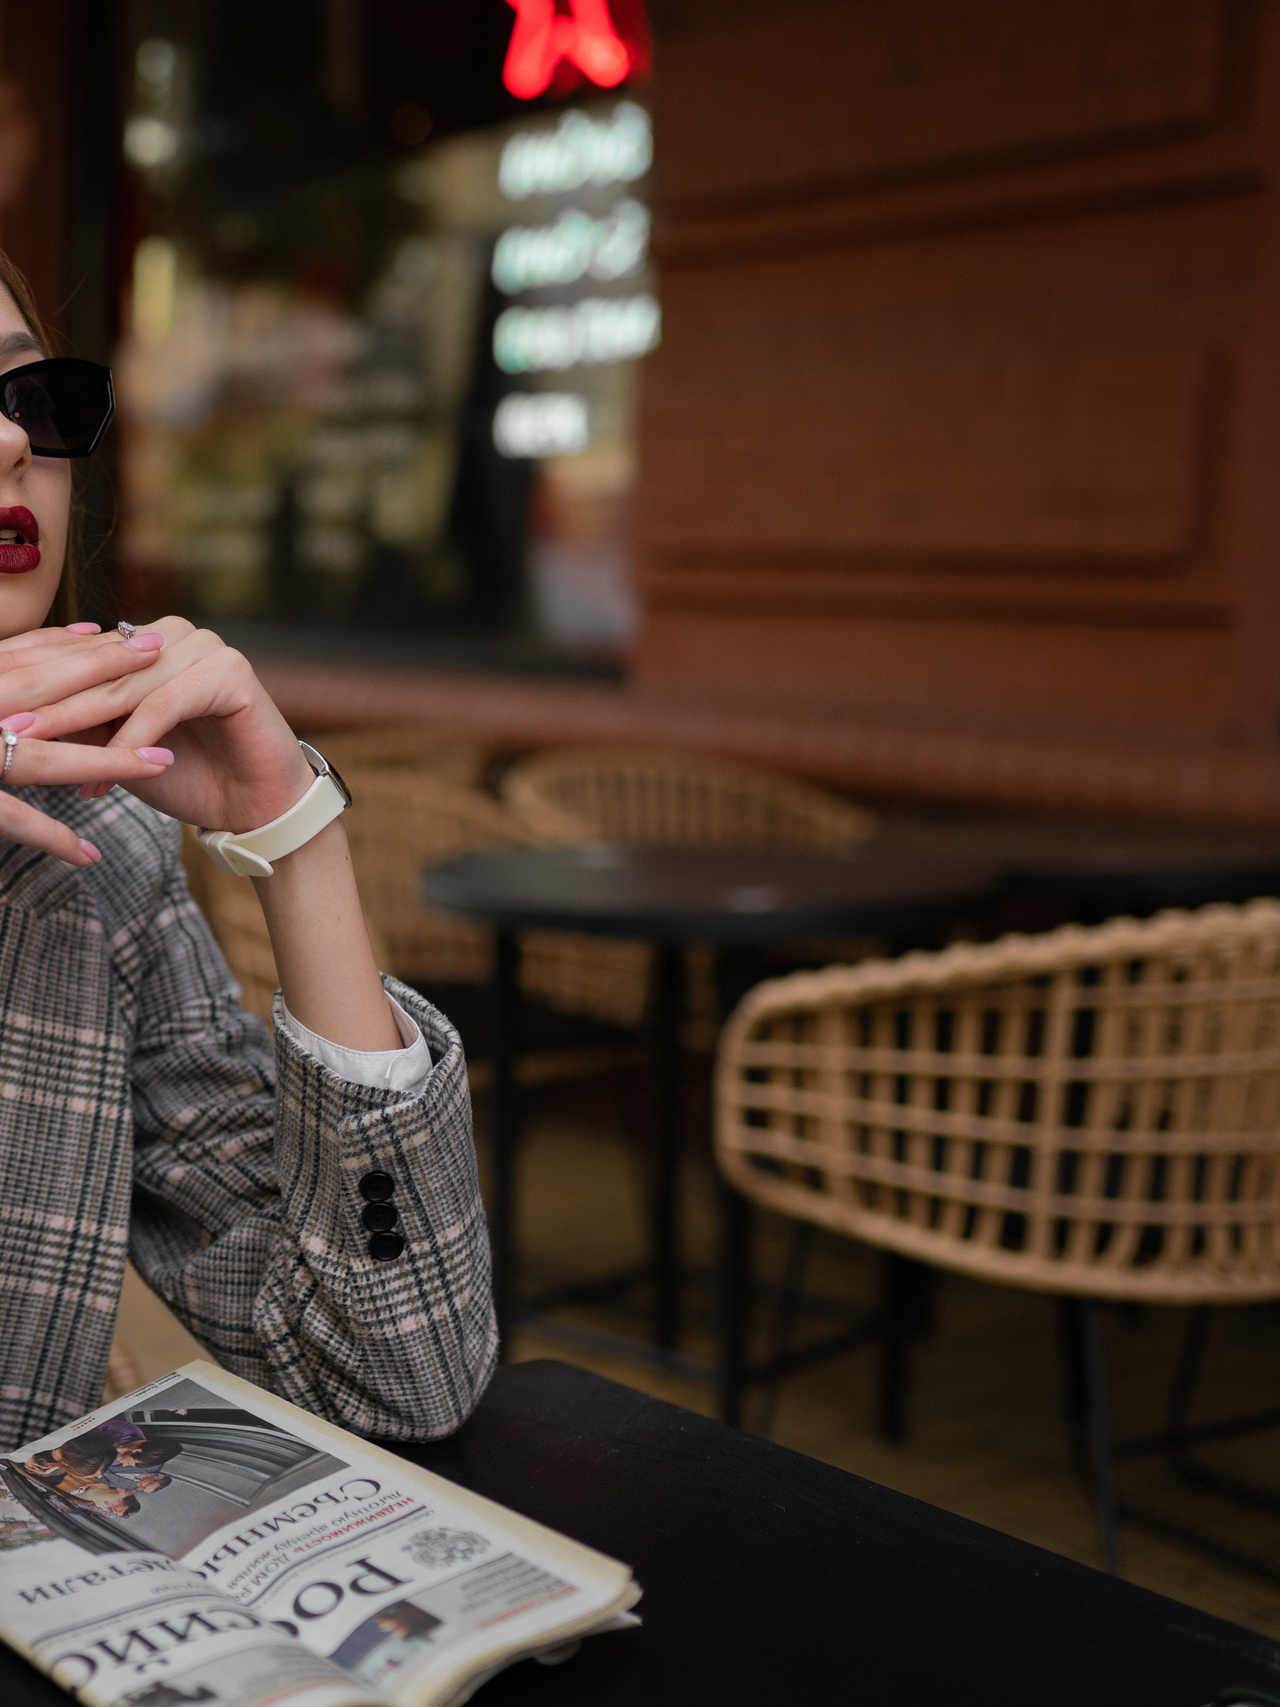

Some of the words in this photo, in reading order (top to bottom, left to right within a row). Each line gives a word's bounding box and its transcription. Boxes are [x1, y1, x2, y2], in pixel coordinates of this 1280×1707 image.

[293, 1497, 414, 1554] НЕДВИЖИМОСТЬ
[332, 1490, 402, 1527] льготную
[274, 1524, 329, 1552] аренду
[19, 1558, 176, 1604] детали
[227, 1550, 272, 1590] жилья
